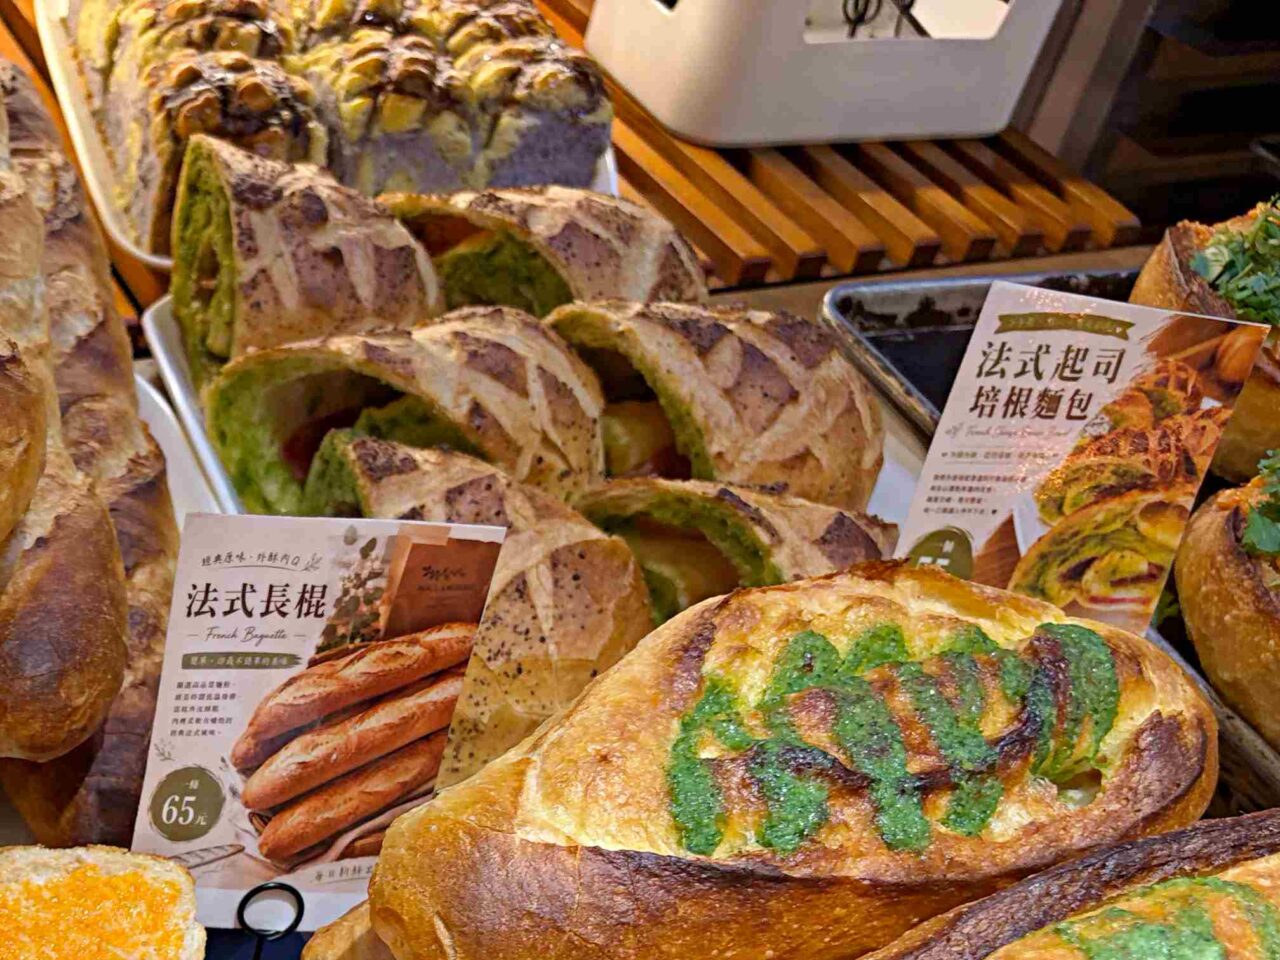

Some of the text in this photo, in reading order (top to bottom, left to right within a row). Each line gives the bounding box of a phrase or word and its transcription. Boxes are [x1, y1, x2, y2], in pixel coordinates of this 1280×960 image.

[975, 341, 1127, 384] 法式起司
[968, 385, 1093, 422] 培根麵包
[185, 581, 329, 620] 法式長棍
[204, 625, 289, 648] French Baguette
